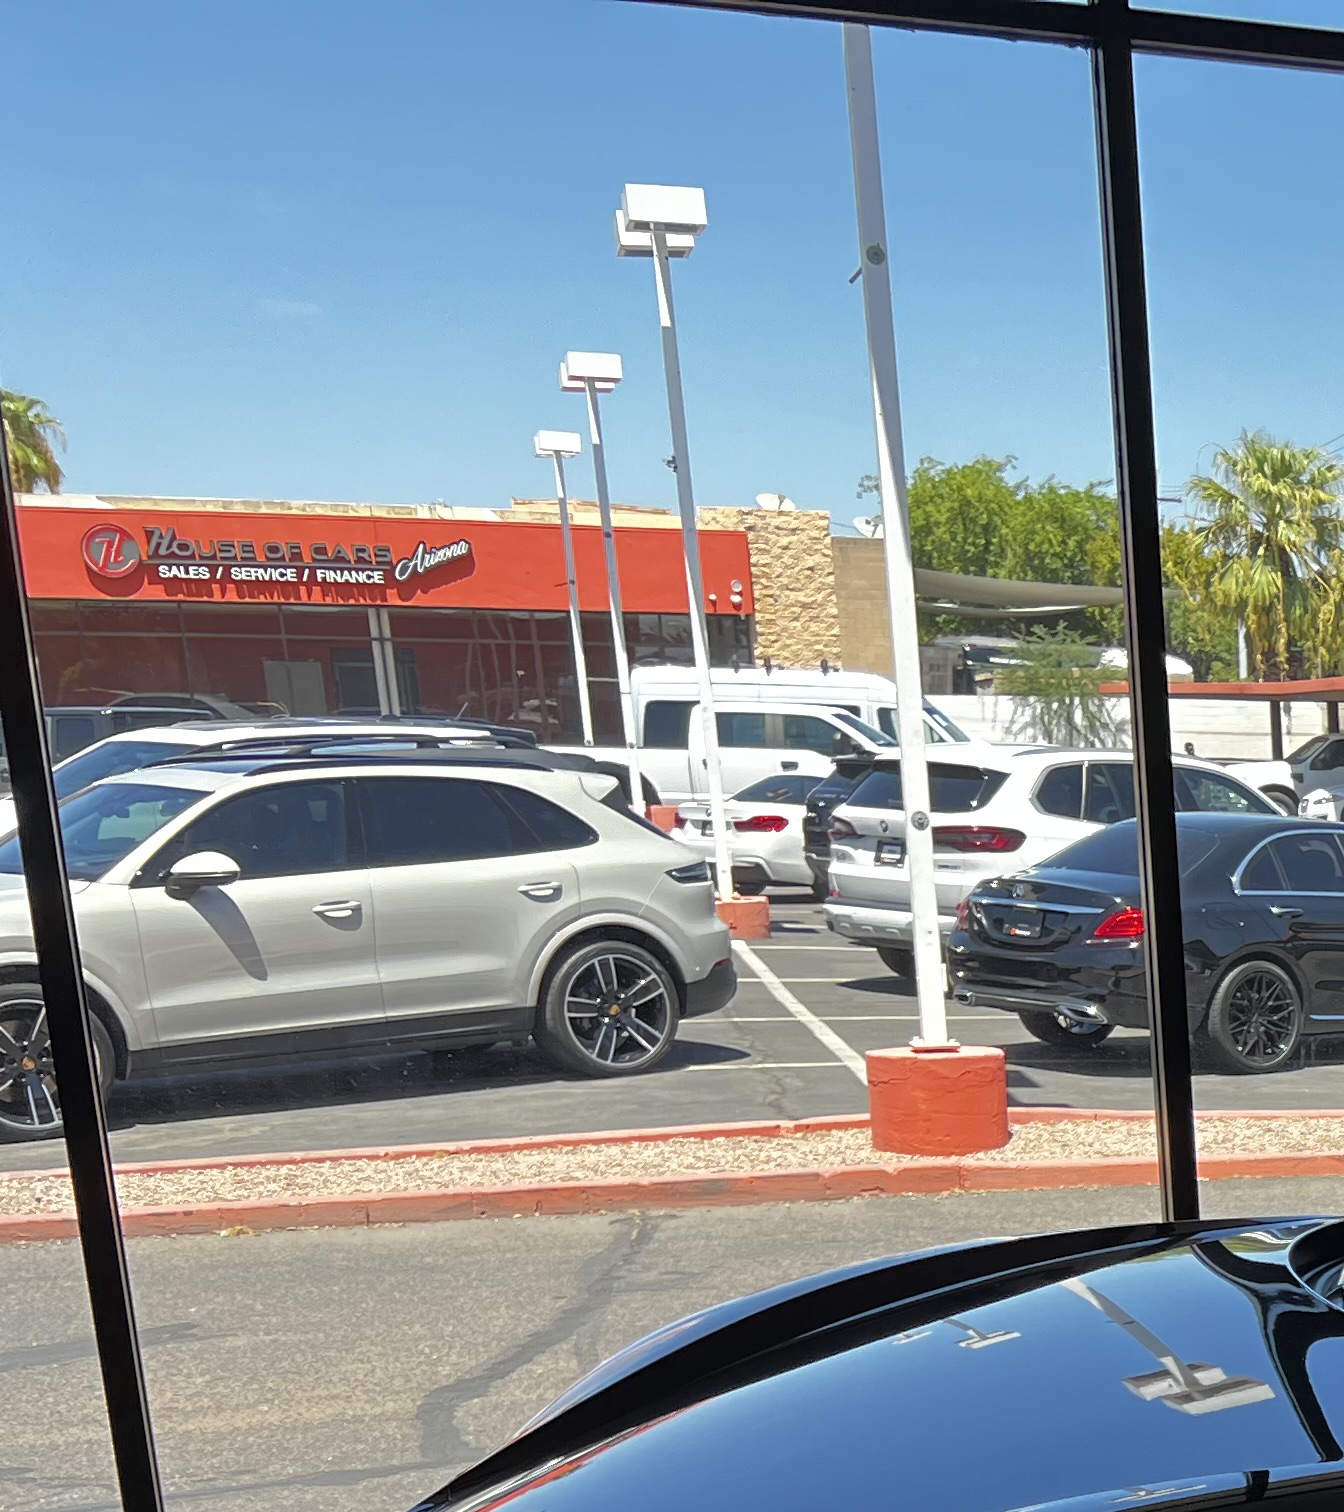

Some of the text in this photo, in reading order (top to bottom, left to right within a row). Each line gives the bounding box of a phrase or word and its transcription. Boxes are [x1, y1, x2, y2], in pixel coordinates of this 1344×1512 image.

[142, 526, 392, 563] HOUSE OF CARS
[394, 540, 470, 581] Arizona
[158, 565, 211, 580] SALES
[229, 566, 298, 582] SERVICE
[315, 568, 385, 584] FINANCE
